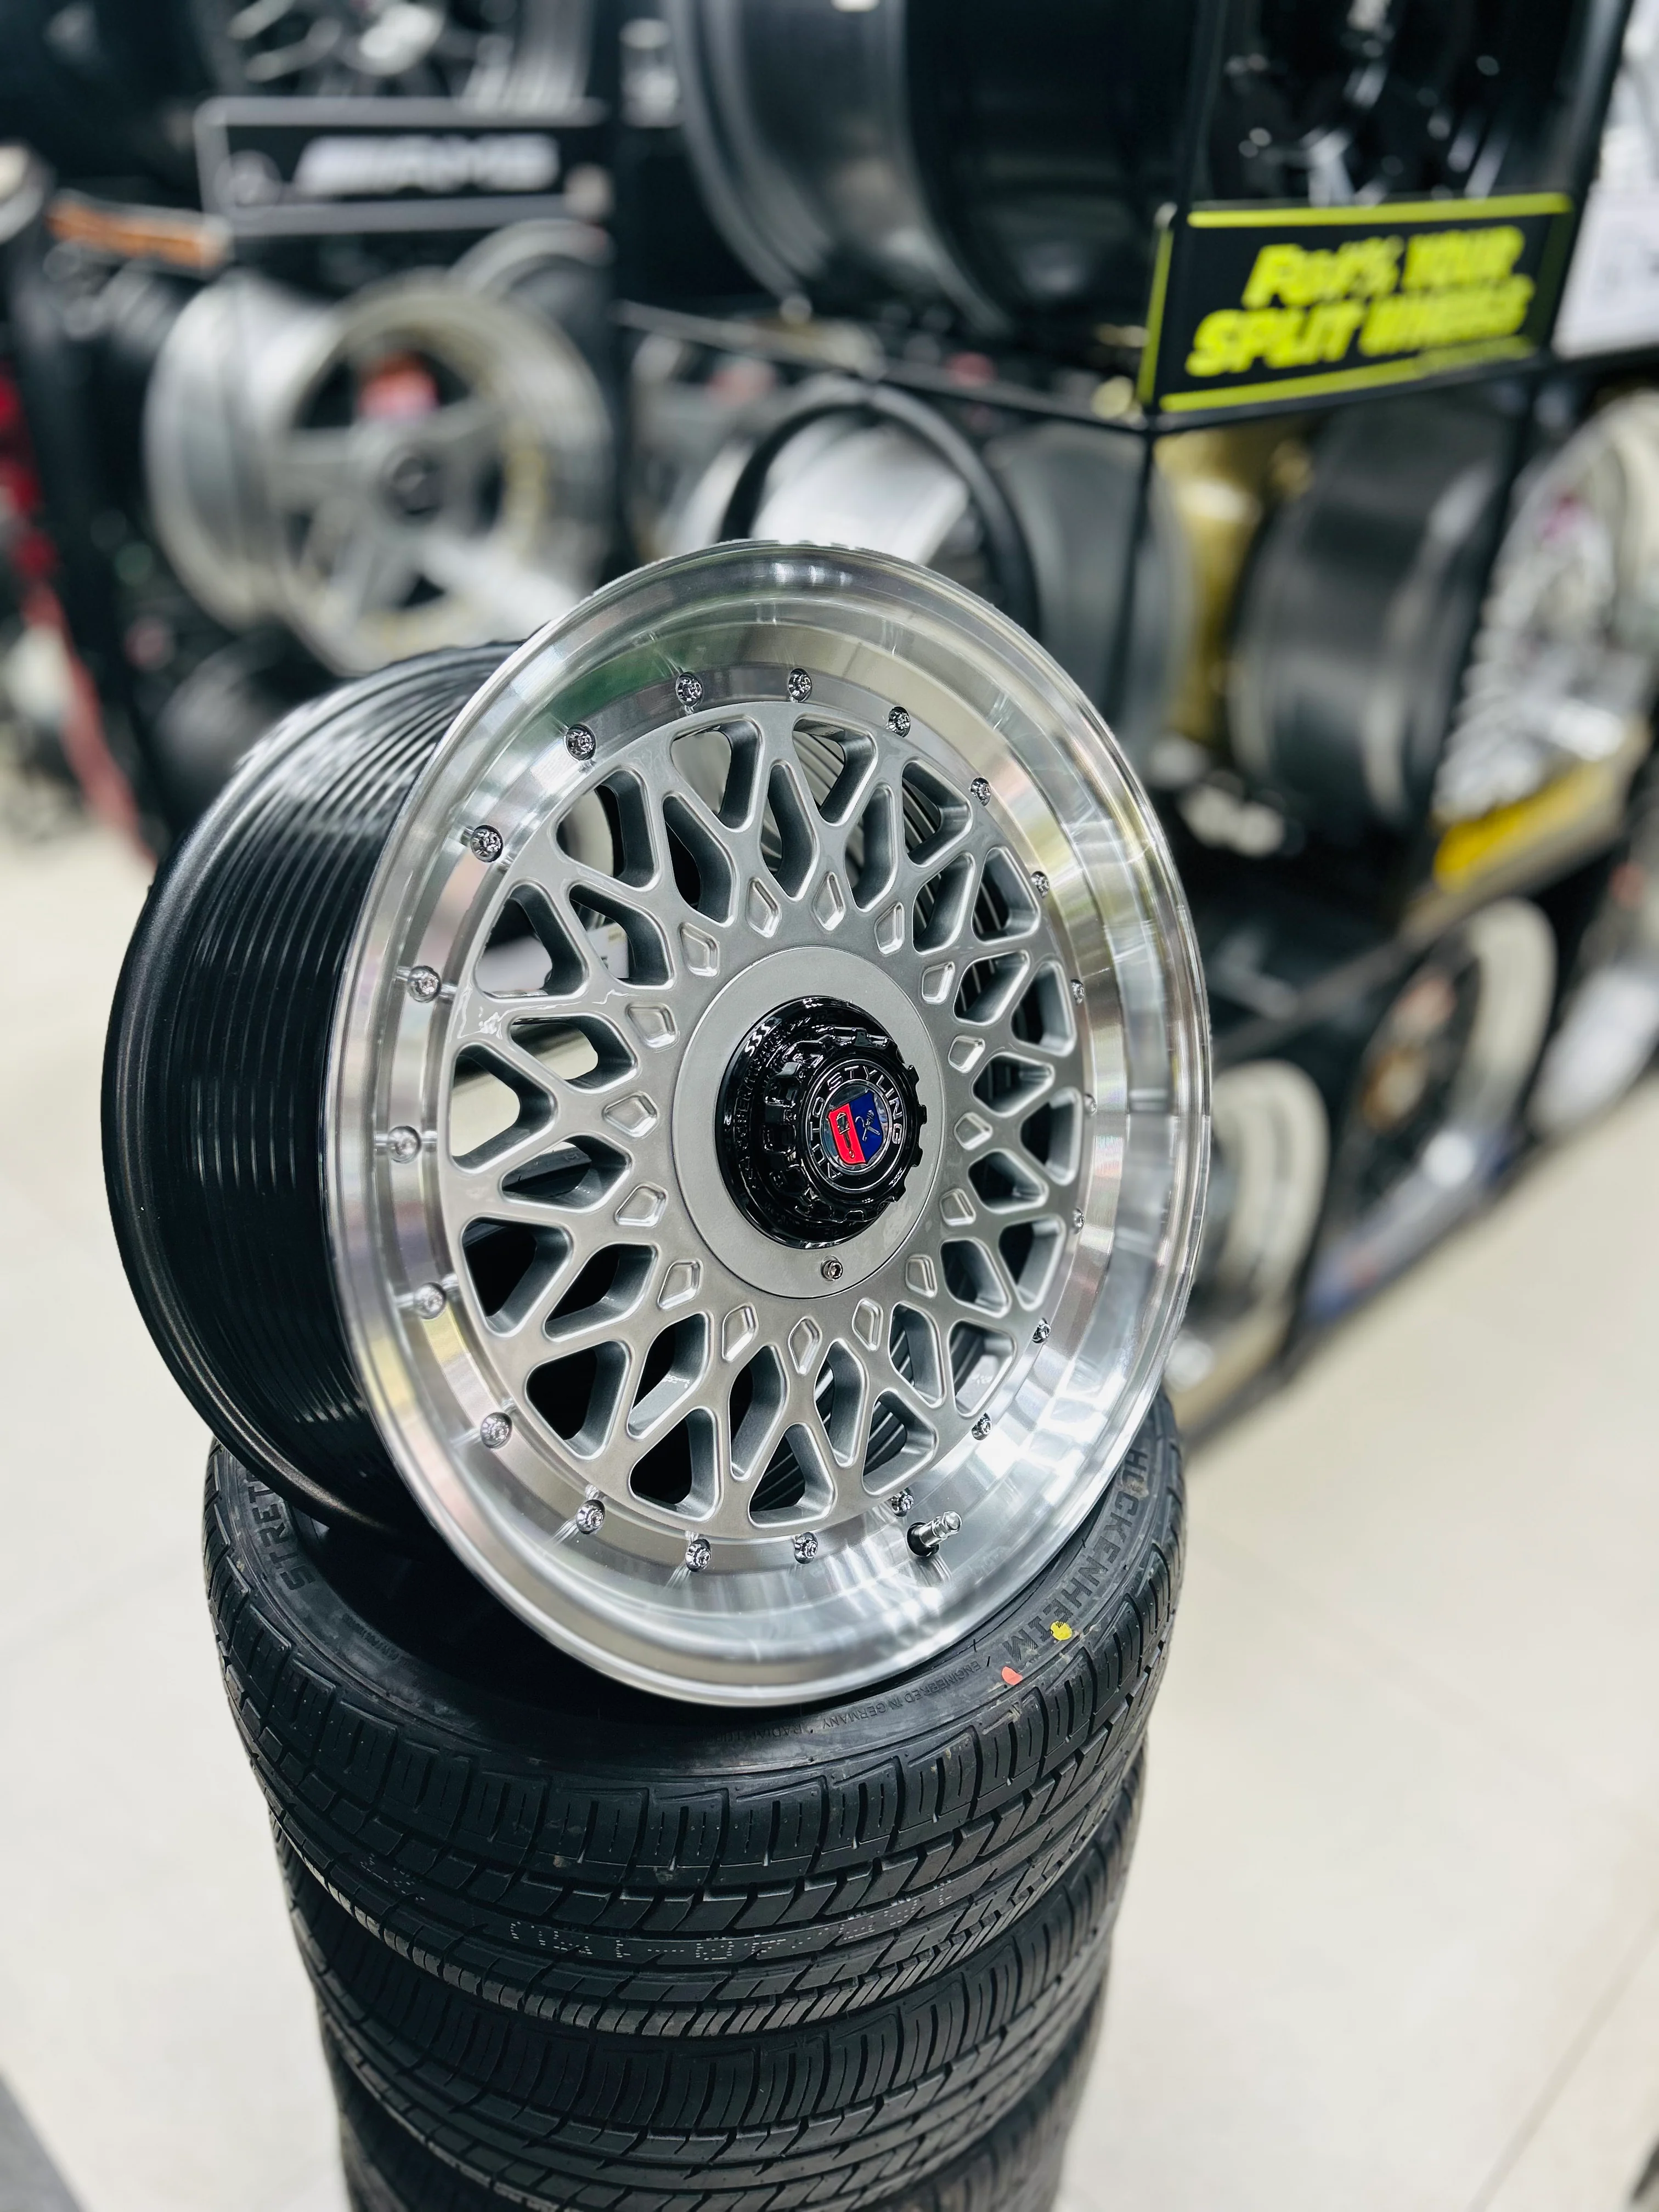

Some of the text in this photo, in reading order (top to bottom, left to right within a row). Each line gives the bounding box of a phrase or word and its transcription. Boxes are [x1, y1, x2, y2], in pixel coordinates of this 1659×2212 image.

[809, 1096, 843, 1182] AUTO
[827, 1064, 903, 1145] STYLING
[822, 1660, 981, 1730] ENGINEERED IN GERMANY
